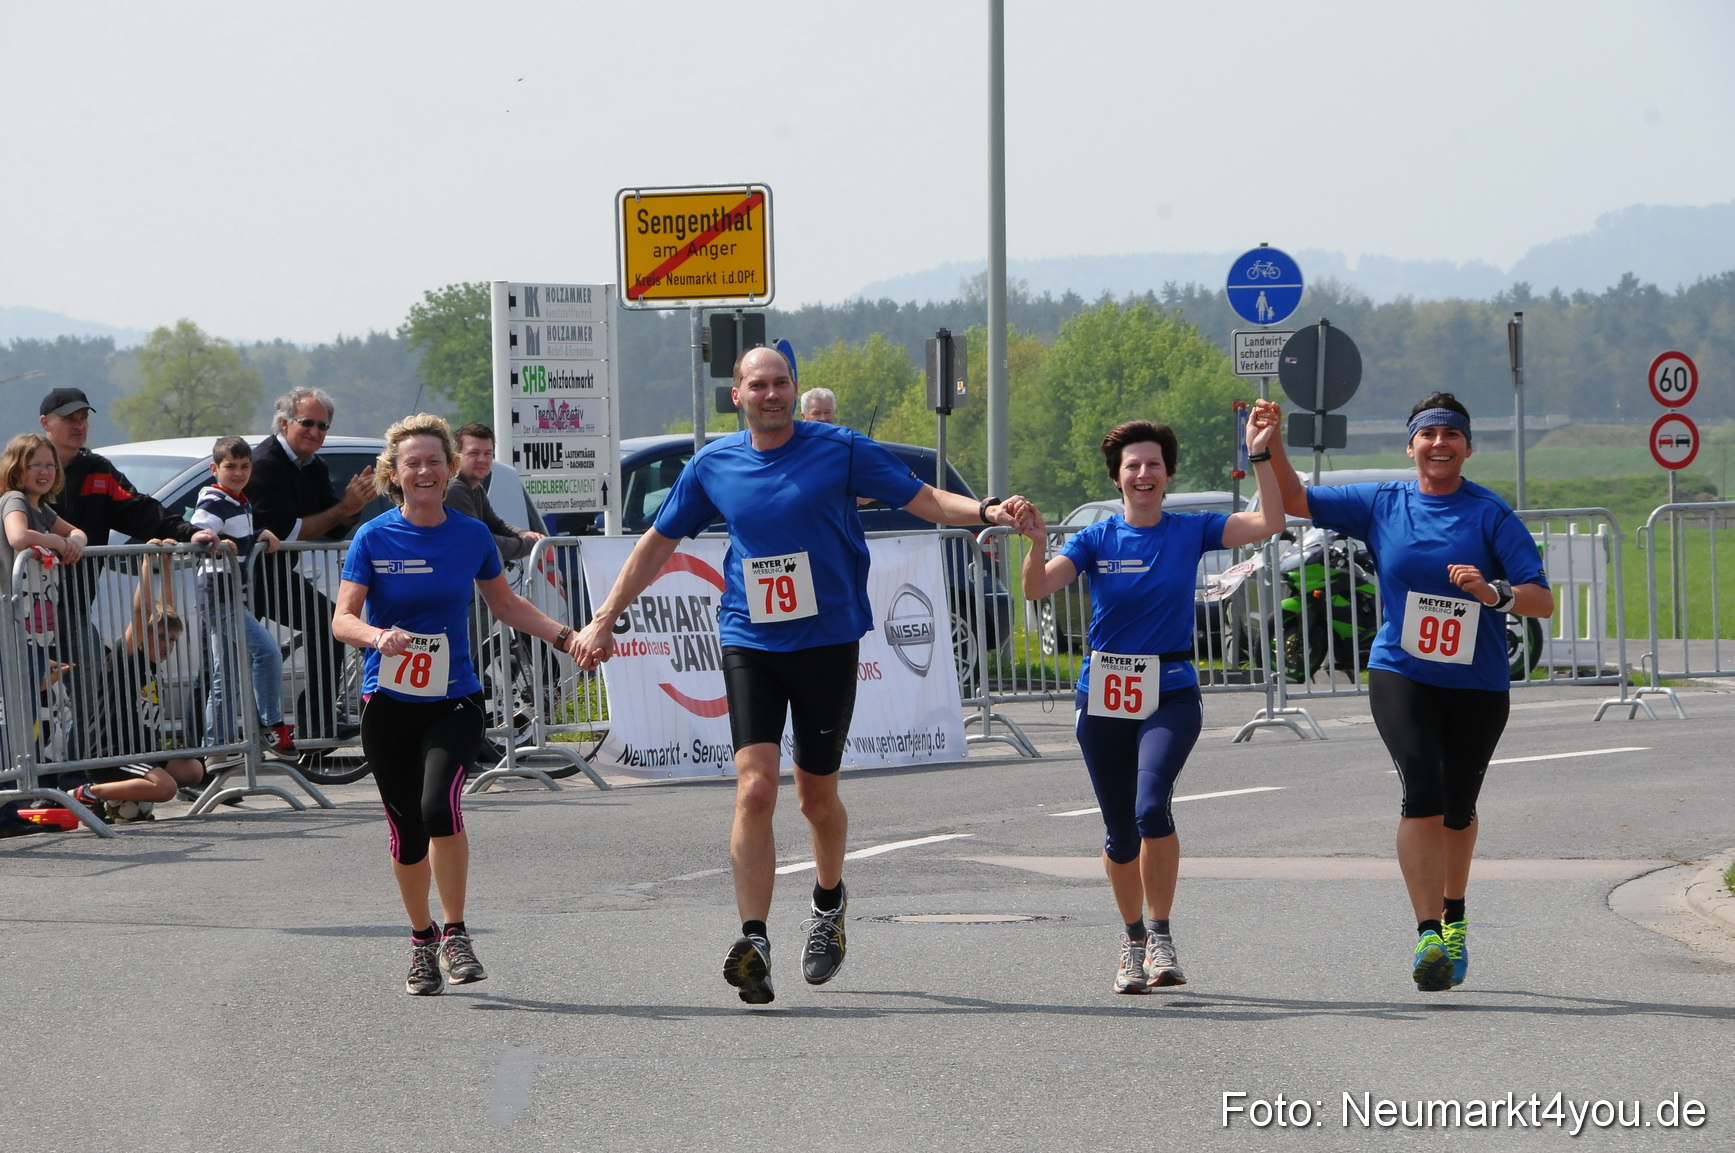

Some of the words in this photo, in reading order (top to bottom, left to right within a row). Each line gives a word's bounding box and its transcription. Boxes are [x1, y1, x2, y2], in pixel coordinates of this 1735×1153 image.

[637, 205, 753, 241] Sengenthal
[653, 245, 679, 258] am
[687, 240, 738, 260] Anger
[635, 273, 661, 287] Kreis
[666, 271, 717, 286] Neumarkt
[722, 269, 758, 285] i.d.OPf.
[545, 287, 592, 304] HOLZAMMER
[546, 325, 593, 342] HOLZAMMER
[1244, 336, 1286, 347] Landwirt-
[1240, 361, 1274, 371] Verkehr
[522, 365, 547, 396] SHB
[547, 369, 594, 389] Holzfachmarkt
[1660, 366, 1688, 393] 60
[533, 404, 556, 421] Trend
[523, 442, 563, 470] THULE
[564, 448, 596, 459] LASTENTRÄGER
[569, 460, 595, 469] DACHBOXEN
[525, 479, 597, 495] HEIDELBERGCEMENT
[535, 499, 570, 512] lungszentrum
[570, 498, 597, 511] Sengenthal
[752, 559, 782, 569] MEYER
[752, 567, 784, 575] WERBUNG
[758, 575, 797, 614] 79
[1419, 597, 1453, 609] MEYER
[1418, 605, 1452, 614] WERBUNG
[1418, 616, 1462, 657] 99
[1101, 655, 1132, 666] MEYER
[1101, 664, 1133, 672] WERBUNG
[394, 651, 432, 689] 78
[856, 661, 883, 682] ORS
[1103, 673, 1143, 714] 65
[852, 726, 946, 760] www.gerhart-jaenig.de
[616, 740, 680, 768] Neumarkt
